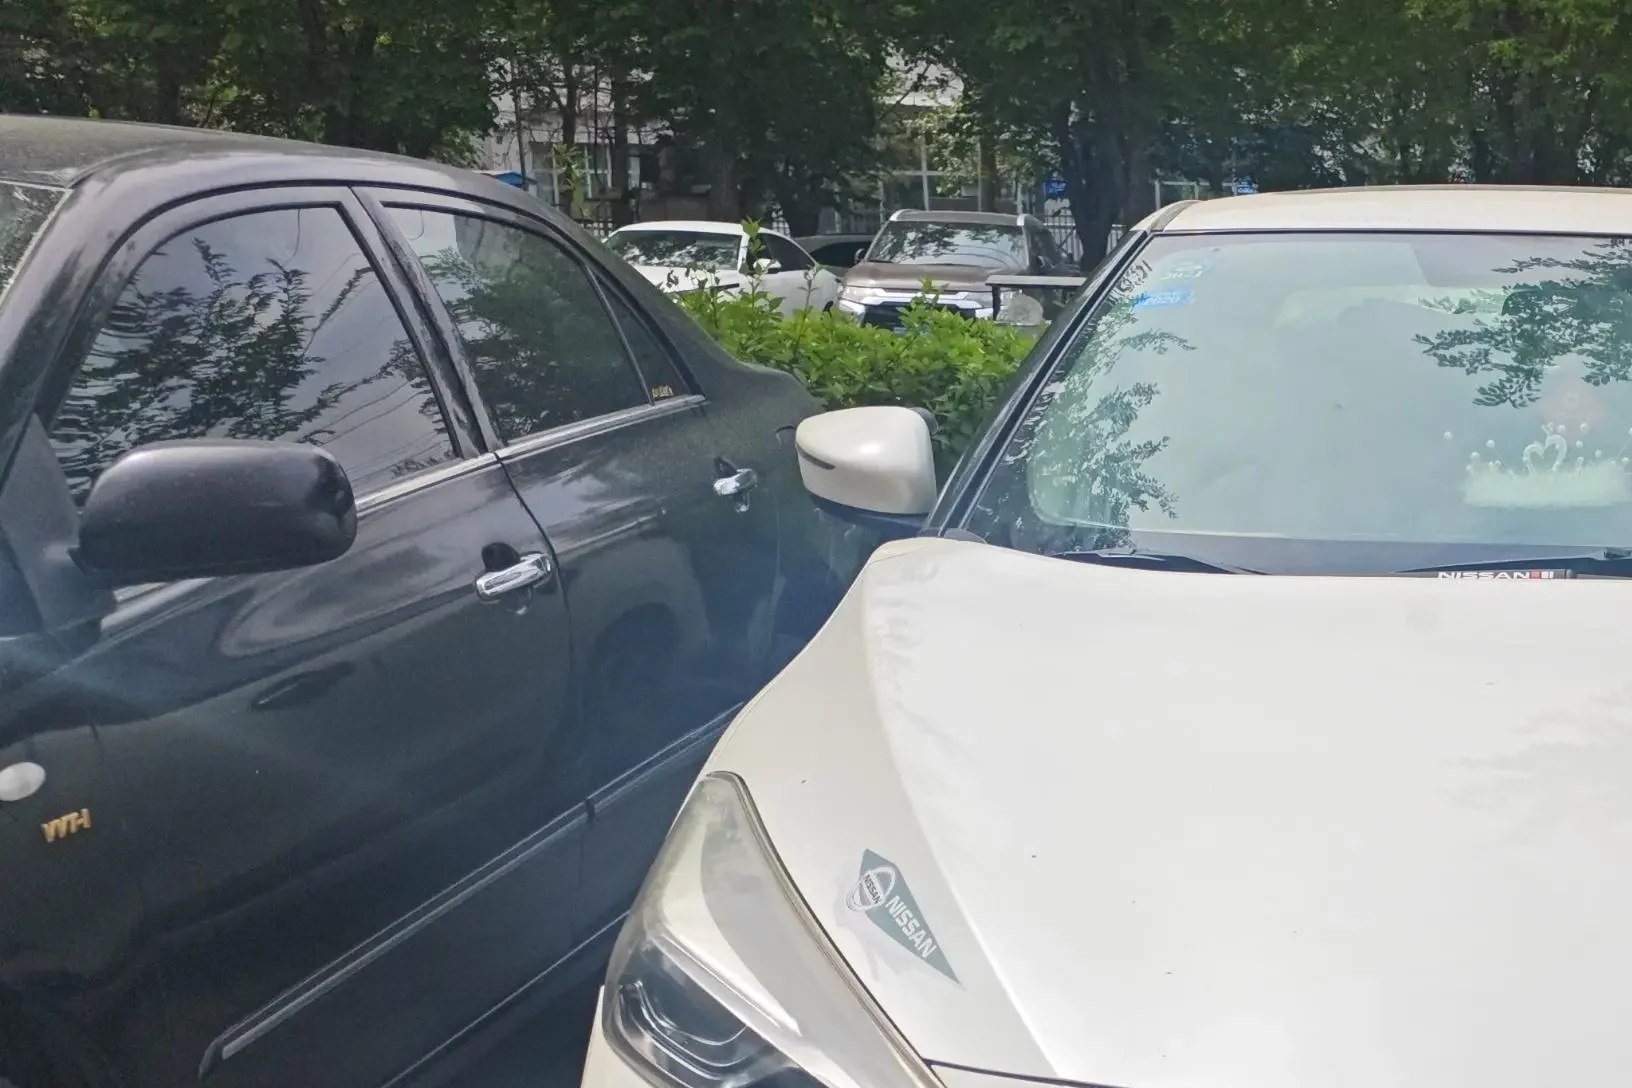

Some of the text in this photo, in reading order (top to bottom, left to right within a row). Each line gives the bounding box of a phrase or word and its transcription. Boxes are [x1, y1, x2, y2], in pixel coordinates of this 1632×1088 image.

[1438, 571, 1530, 580] NISSAN
[863, 874, 882, 904] NISSAN
[885, 895, 938, 959] NISSAN
